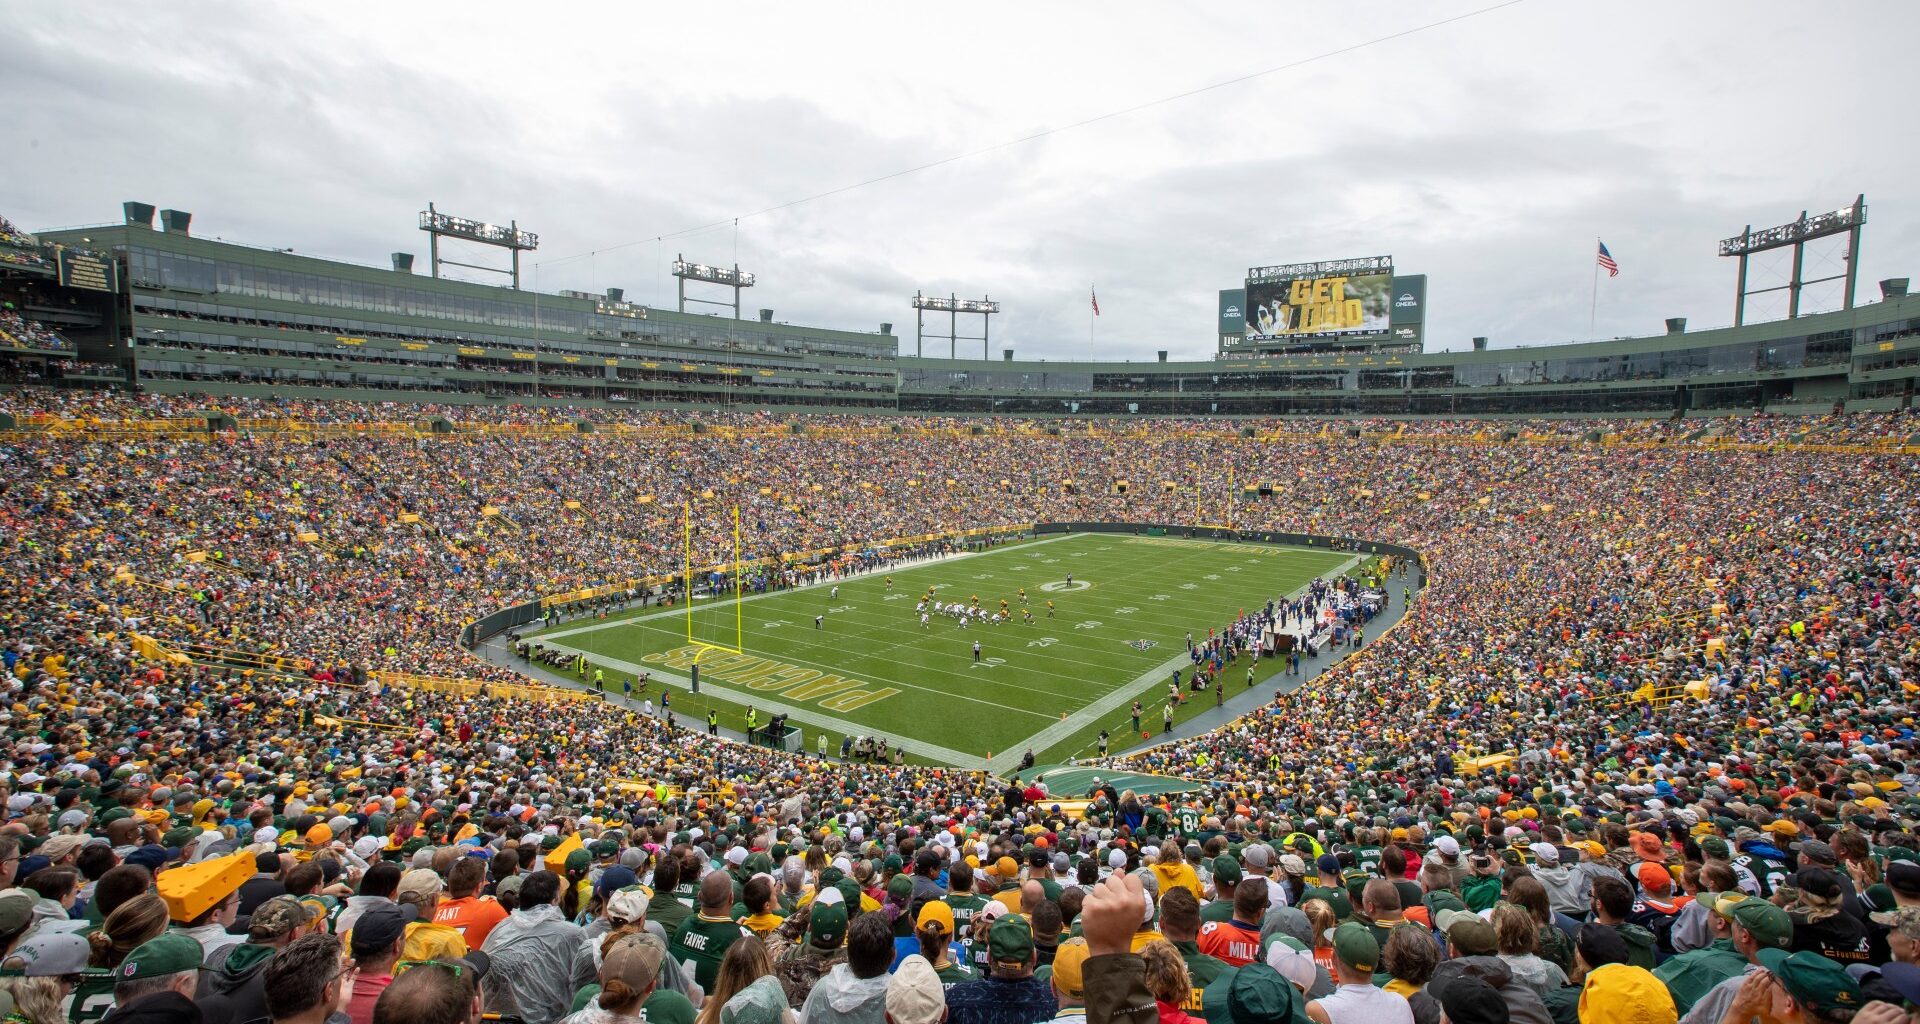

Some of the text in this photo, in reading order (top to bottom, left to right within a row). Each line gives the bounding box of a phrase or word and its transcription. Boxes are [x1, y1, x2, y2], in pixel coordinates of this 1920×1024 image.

[1290, 277, 1348, 305] GET
[1223, 336, 1240, 347] Lite
[641, 645, 903, 713] PACKERS
[435, 906, 461, 922] FANT
[952, 908, 974, 919] OWNER
[683, 931, 710, 950] FAVRE
[1229, 941, 1259, 960] MILL
